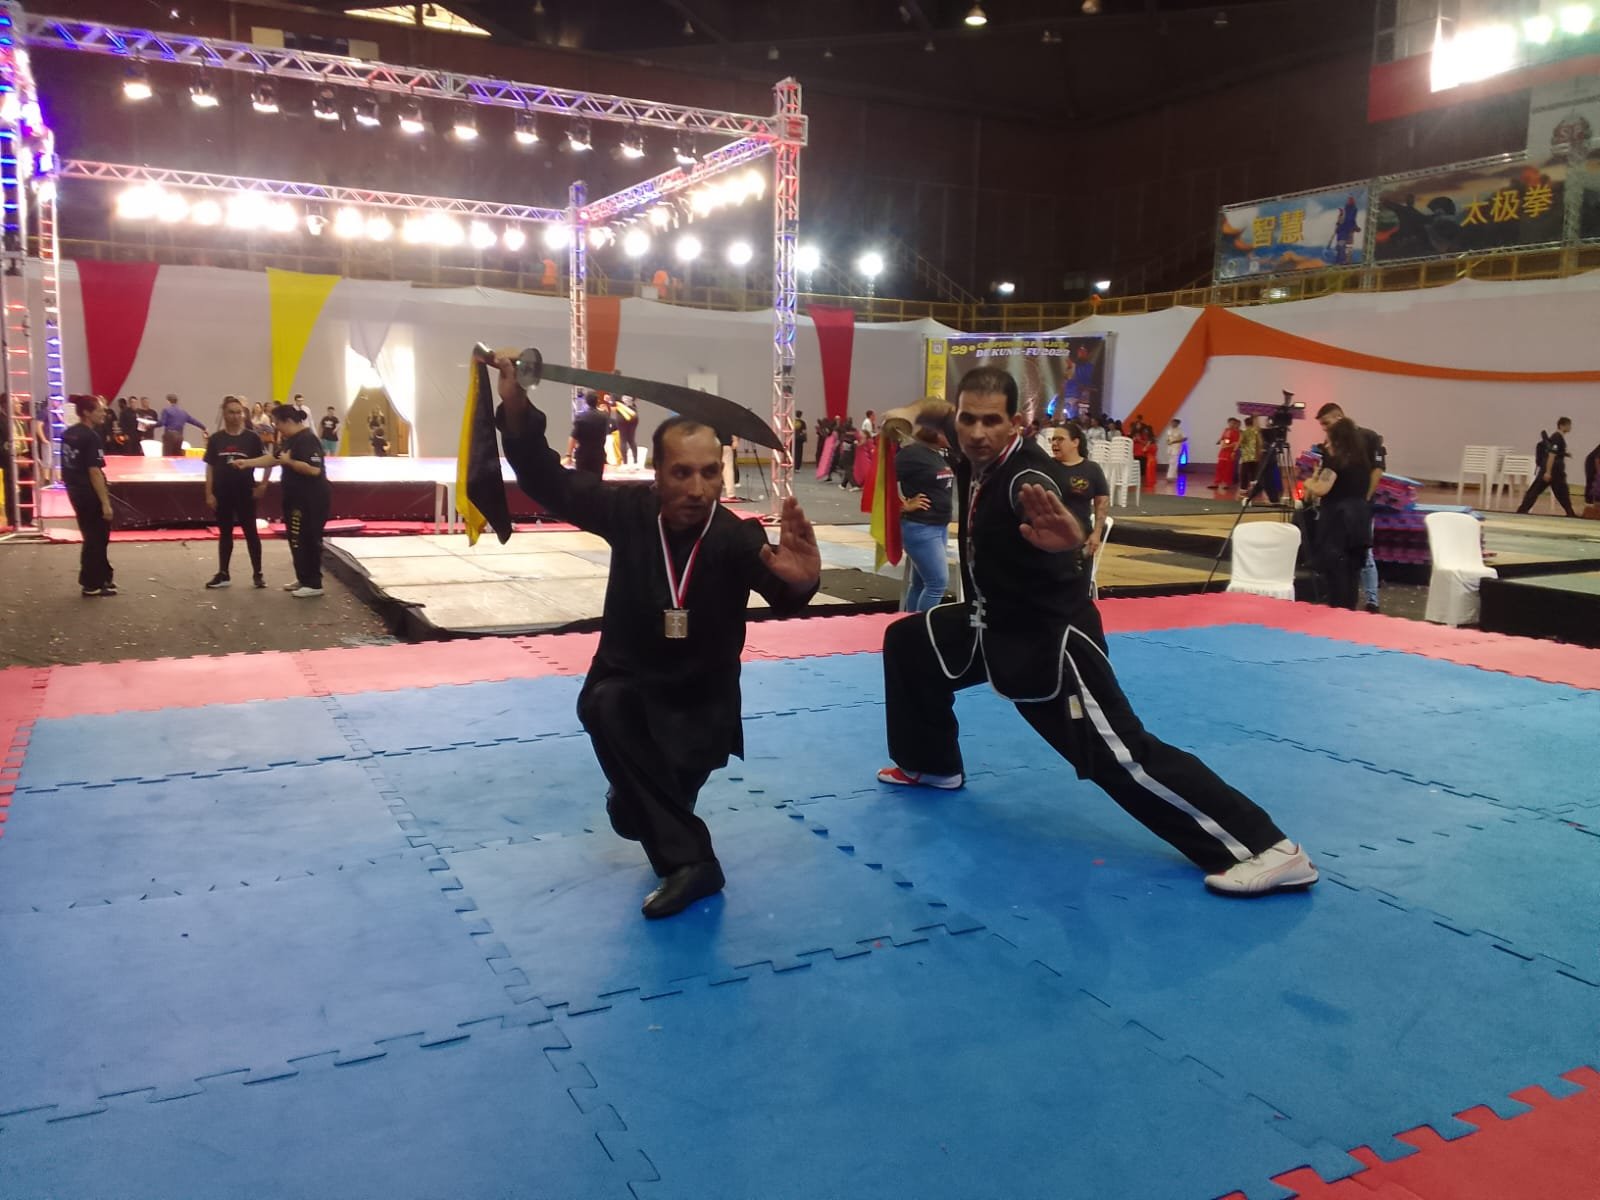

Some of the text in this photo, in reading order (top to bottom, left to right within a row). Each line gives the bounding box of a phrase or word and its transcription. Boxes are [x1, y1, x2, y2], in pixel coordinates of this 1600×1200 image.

[1459, 183, 1554, 228] 太极拳
[1251, 208, 1306, 249] 智慧
